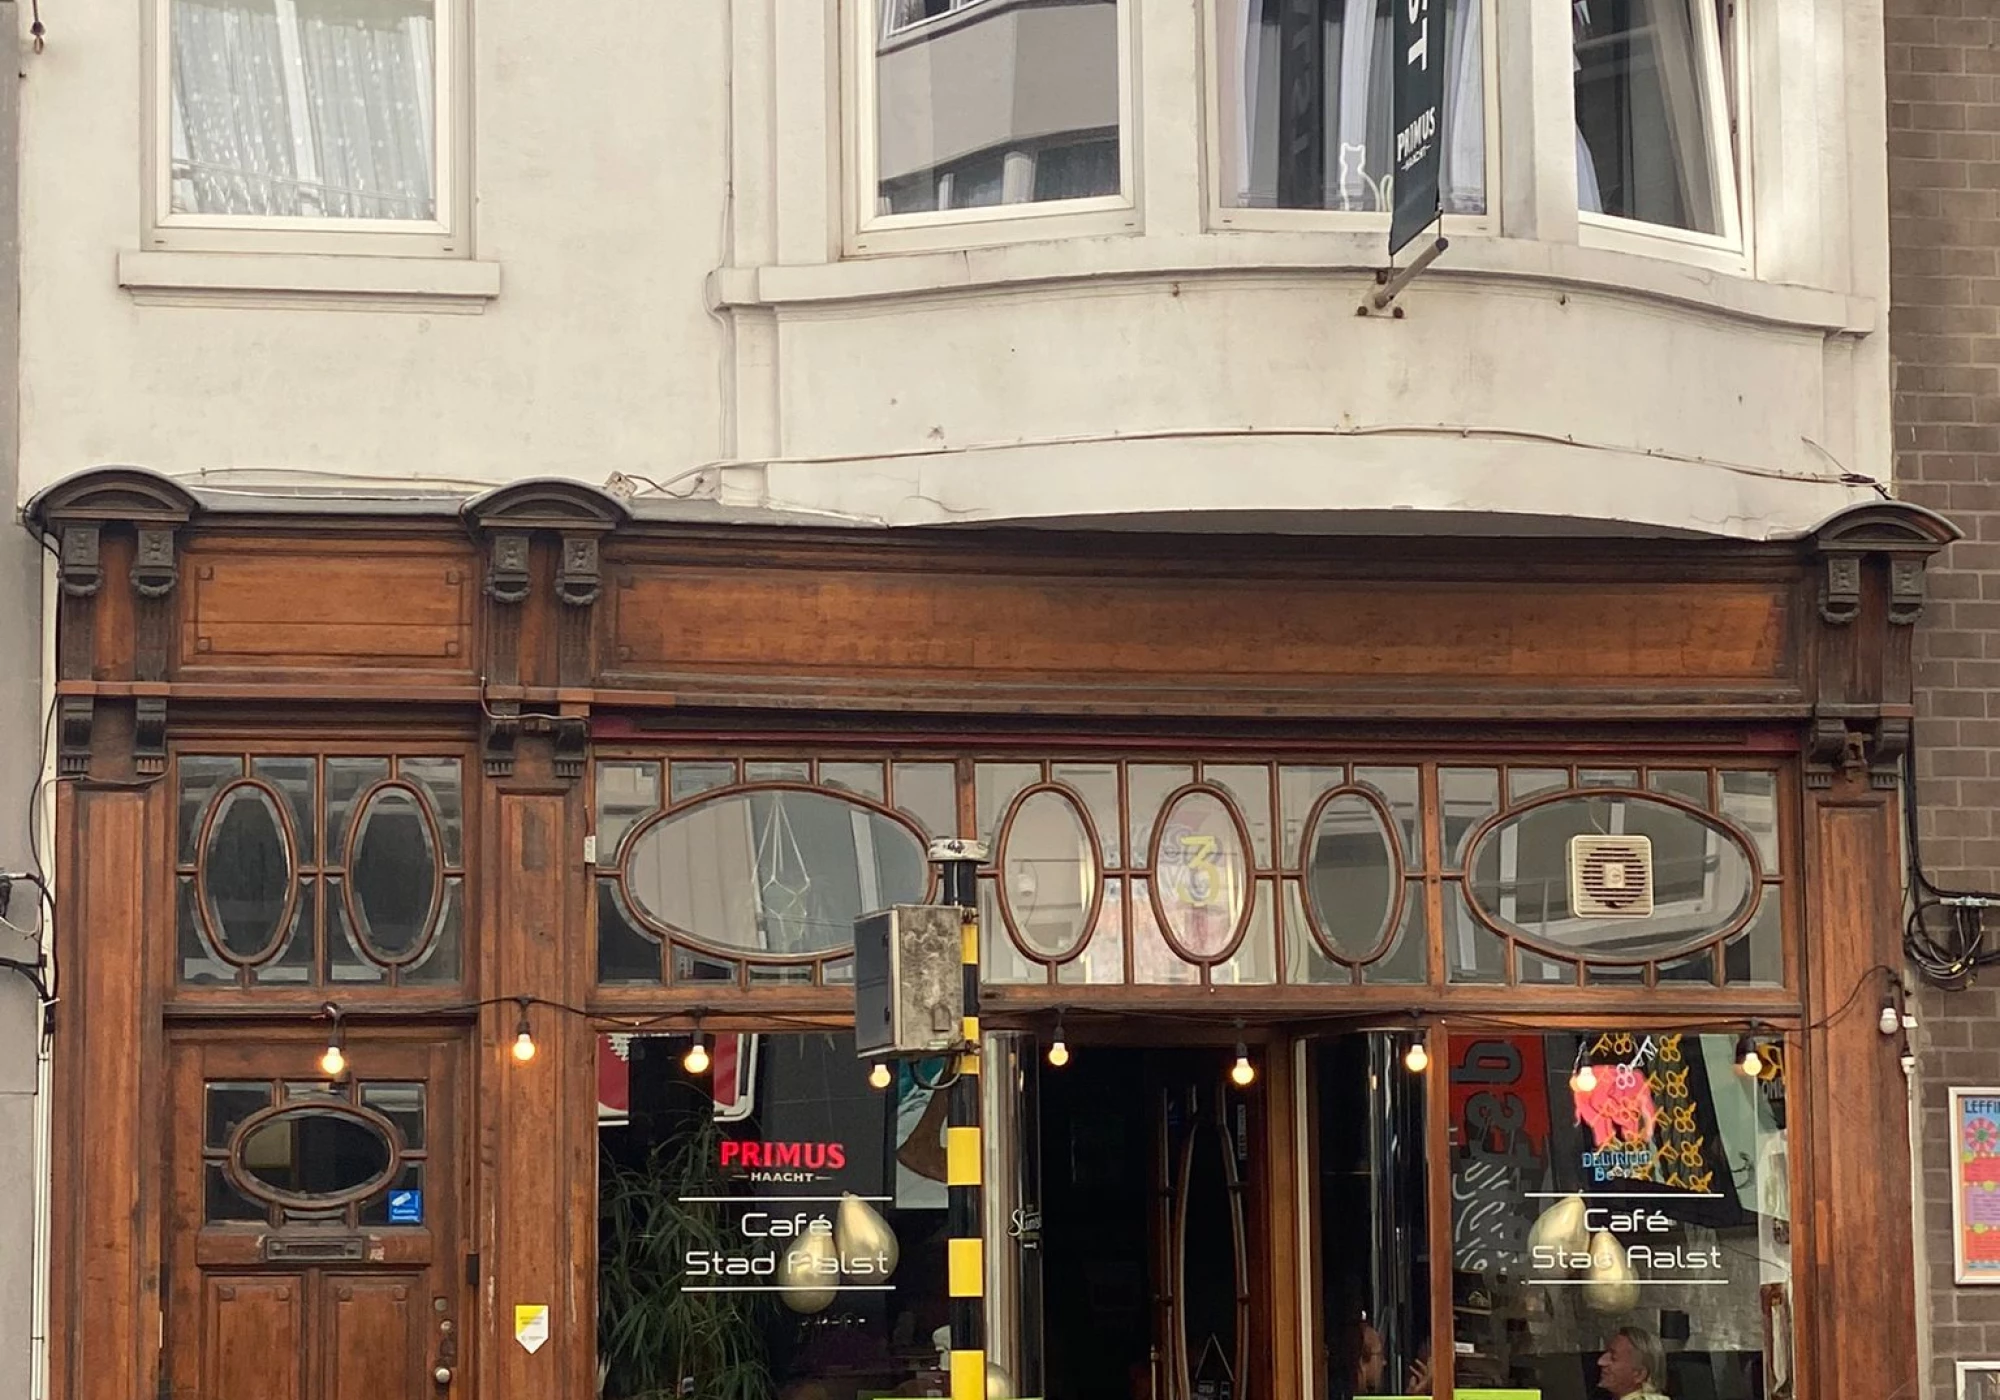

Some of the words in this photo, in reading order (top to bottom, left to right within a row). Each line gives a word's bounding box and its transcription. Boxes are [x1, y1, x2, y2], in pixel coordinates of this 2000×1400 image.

[1396, 106, 1436, 162] PRIMUS
[1964, 1099, 2000, 1114] LEFFI
[719, 1141, 847, 1169] PRIMUS
[750, 1172, 815, 1182] HAACHT
[741, 1213, 833, 1237] Café
[1584, 1208, 1669, 1232] Café
[685, 1251, 775, 1276] Stad
[787, 1250, 889, 1275] Aalst
[1627, 1245, 1721, 1269] Aalst
